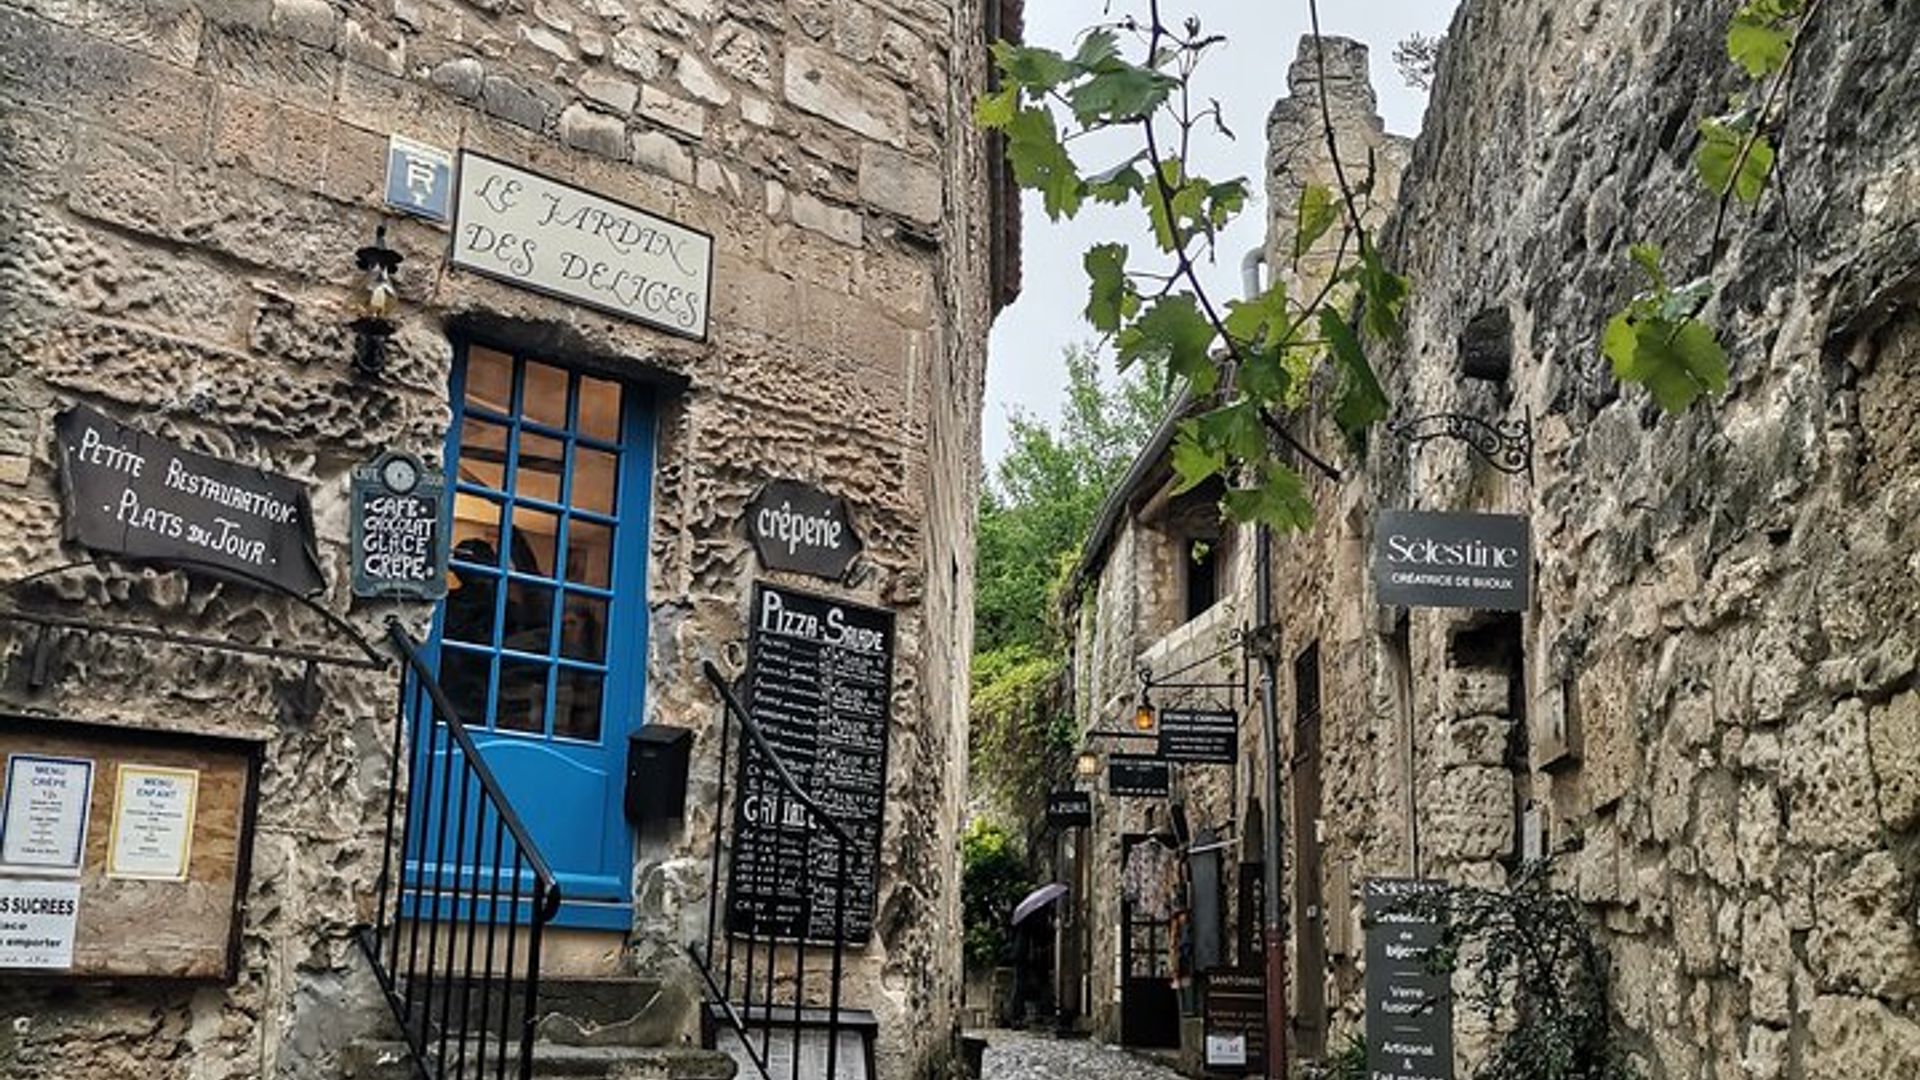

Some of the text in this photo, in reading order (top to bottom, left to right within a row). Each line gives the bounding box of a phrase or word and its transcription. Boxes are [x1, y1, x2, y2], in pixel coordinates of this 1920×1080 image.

[466, 222, 537, 277] DES
[475, 174, 697, 277] LE JARDIN
[211, 516, 266, 565] JOUR
[757, 500, 841, 555] crêperie
[1455, 575, 1470, 587] DE
[1472, 577, 1513, 589] BIJOUX
[1389, 985, 1425, 998] Verre
